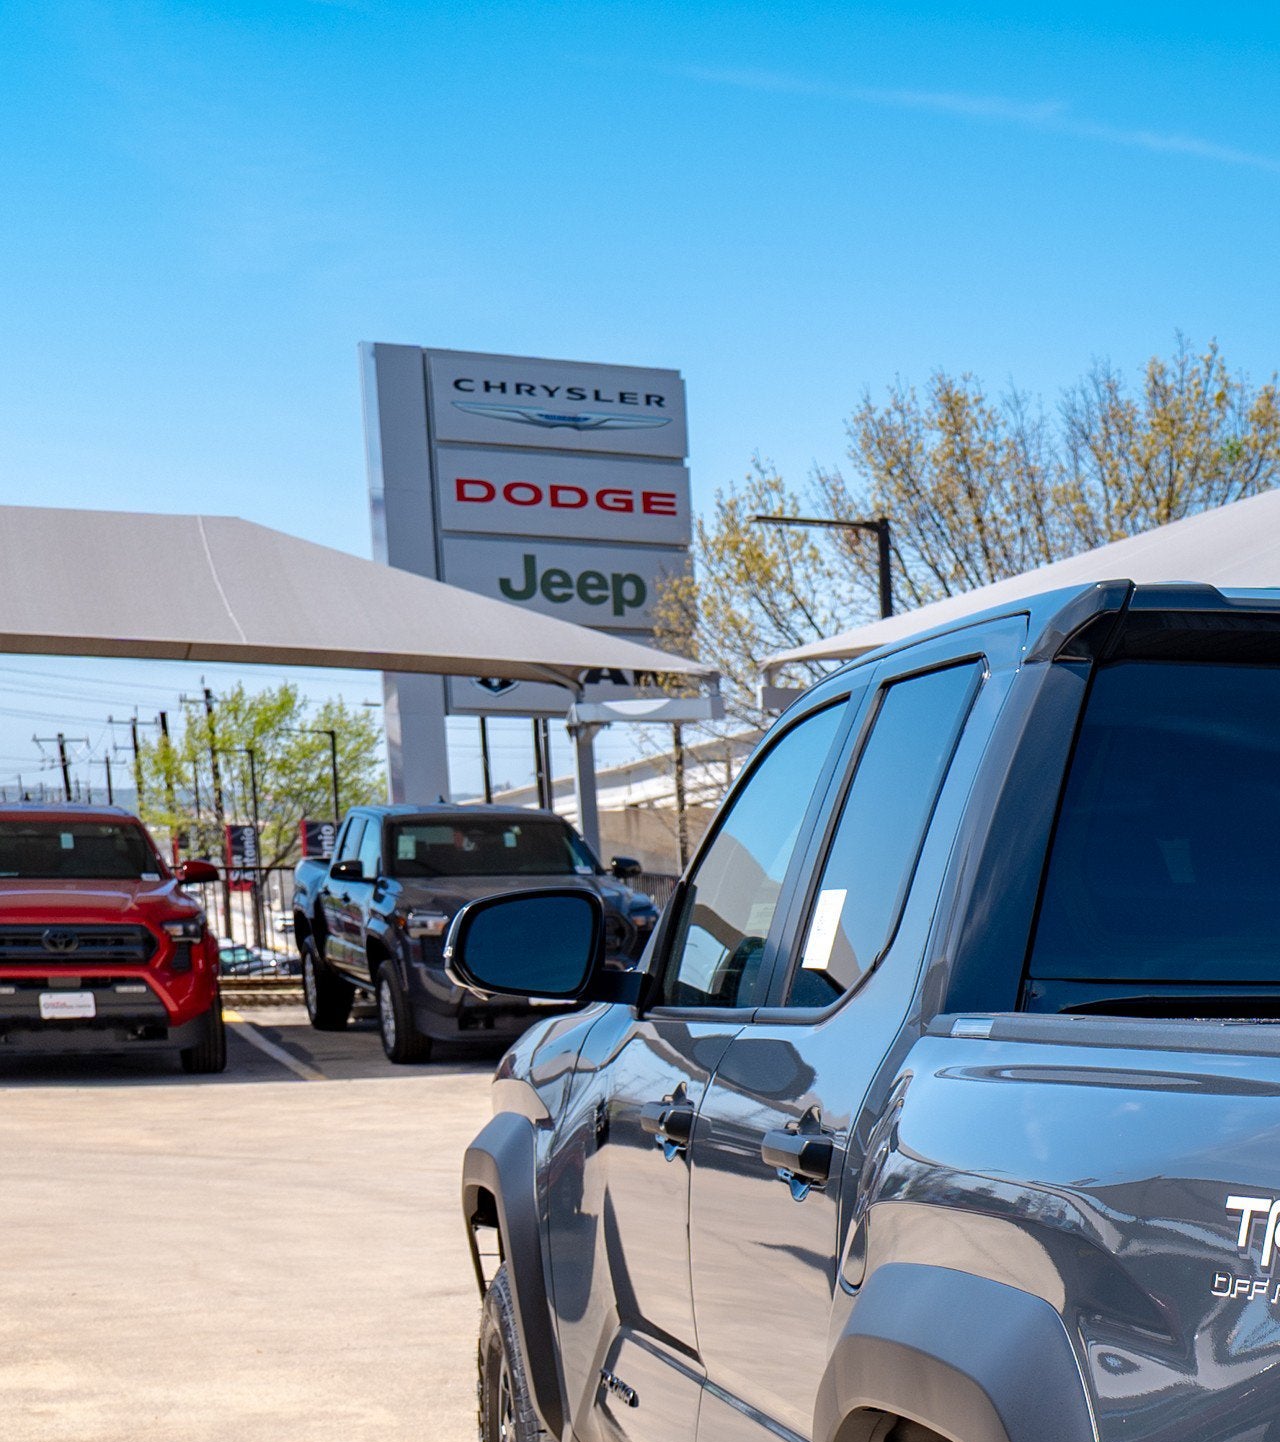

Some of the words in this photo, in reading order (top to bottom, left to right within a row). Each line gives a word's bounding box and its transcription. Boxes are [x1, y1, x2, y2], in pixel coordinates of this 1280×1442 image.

[453, 377, 667, 409] CHRYSLER
[454, 478, 678, 516] DODGE
[499, 553, 647, 617] Jeep
[229, 855, 243, 881] Sn
[1211, 1270, 1270, 1300] OFF
